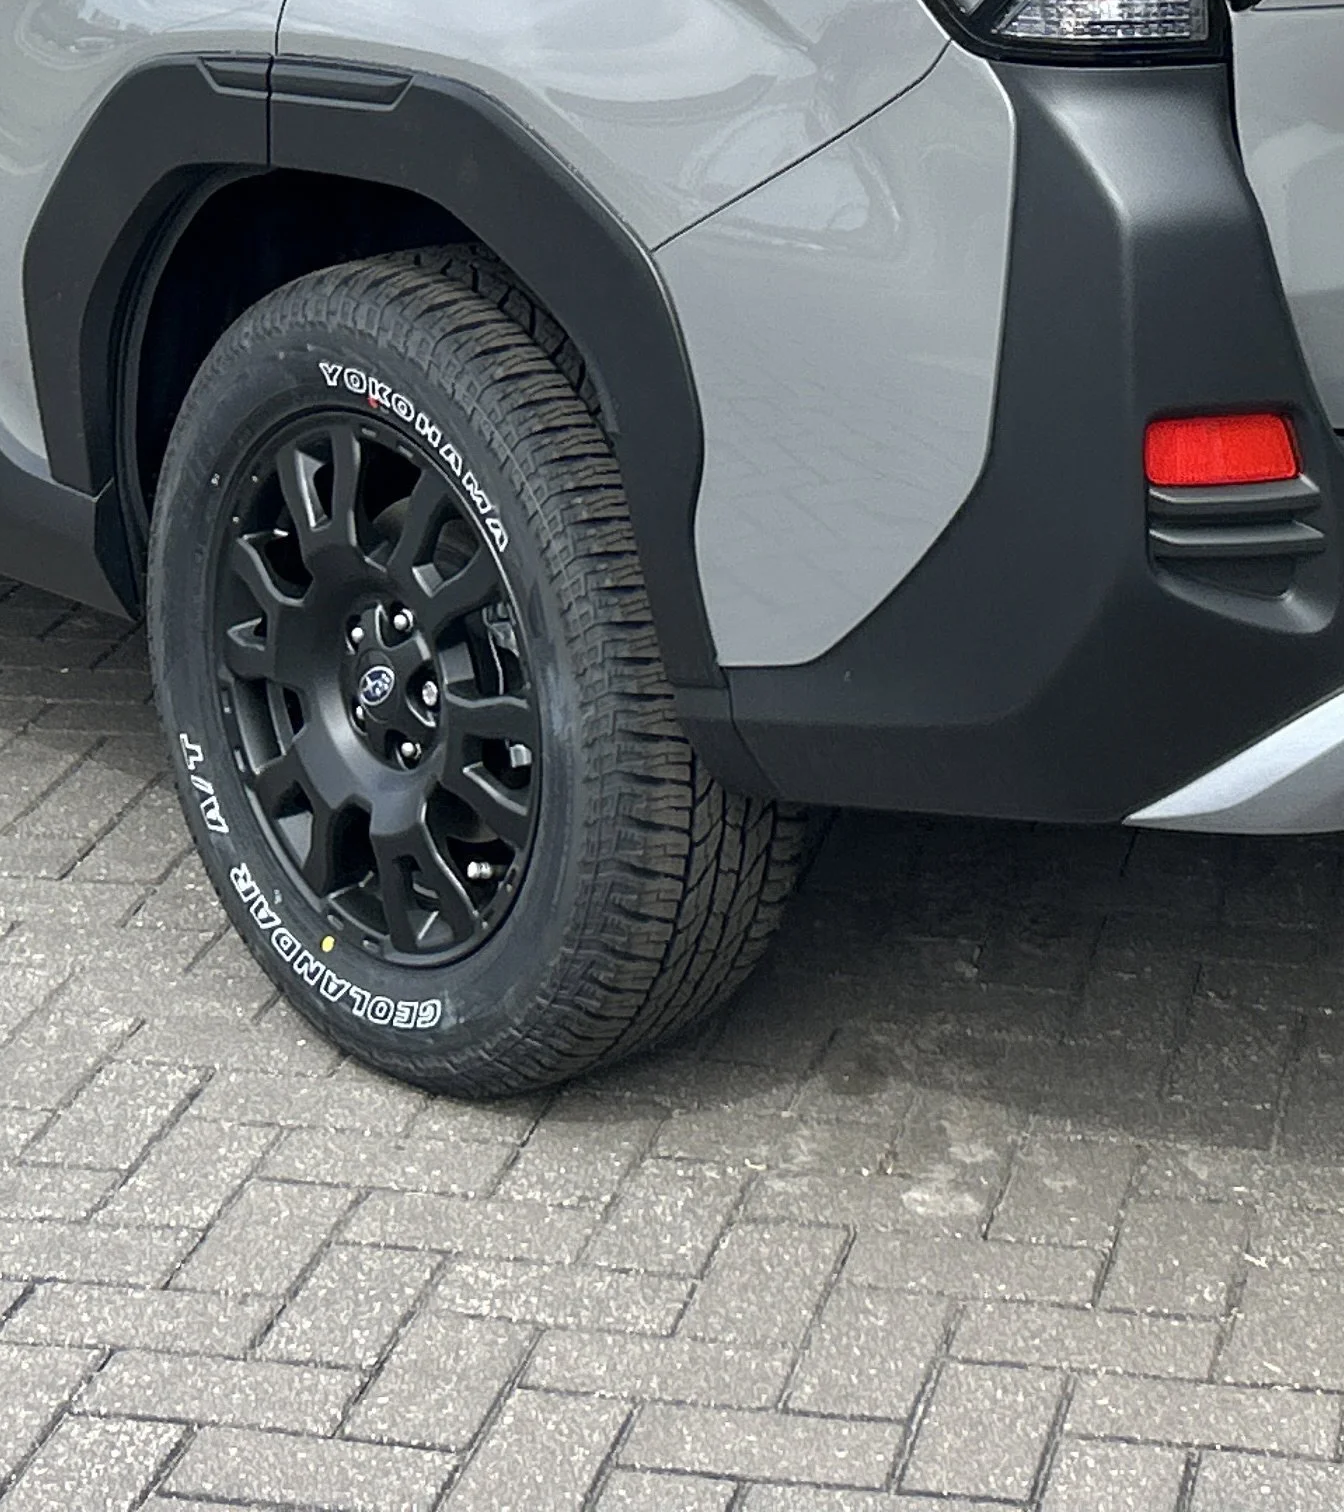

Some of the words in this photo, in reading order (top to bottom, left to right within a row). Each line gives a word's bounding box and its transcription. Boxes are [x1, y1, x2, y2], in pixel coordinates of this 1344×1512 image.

[318, 361, 509, 553] YOKOHAMA
[179, 732, 230, 834] A/T
[229, 862, 442, 1029] GEOLANDAR
